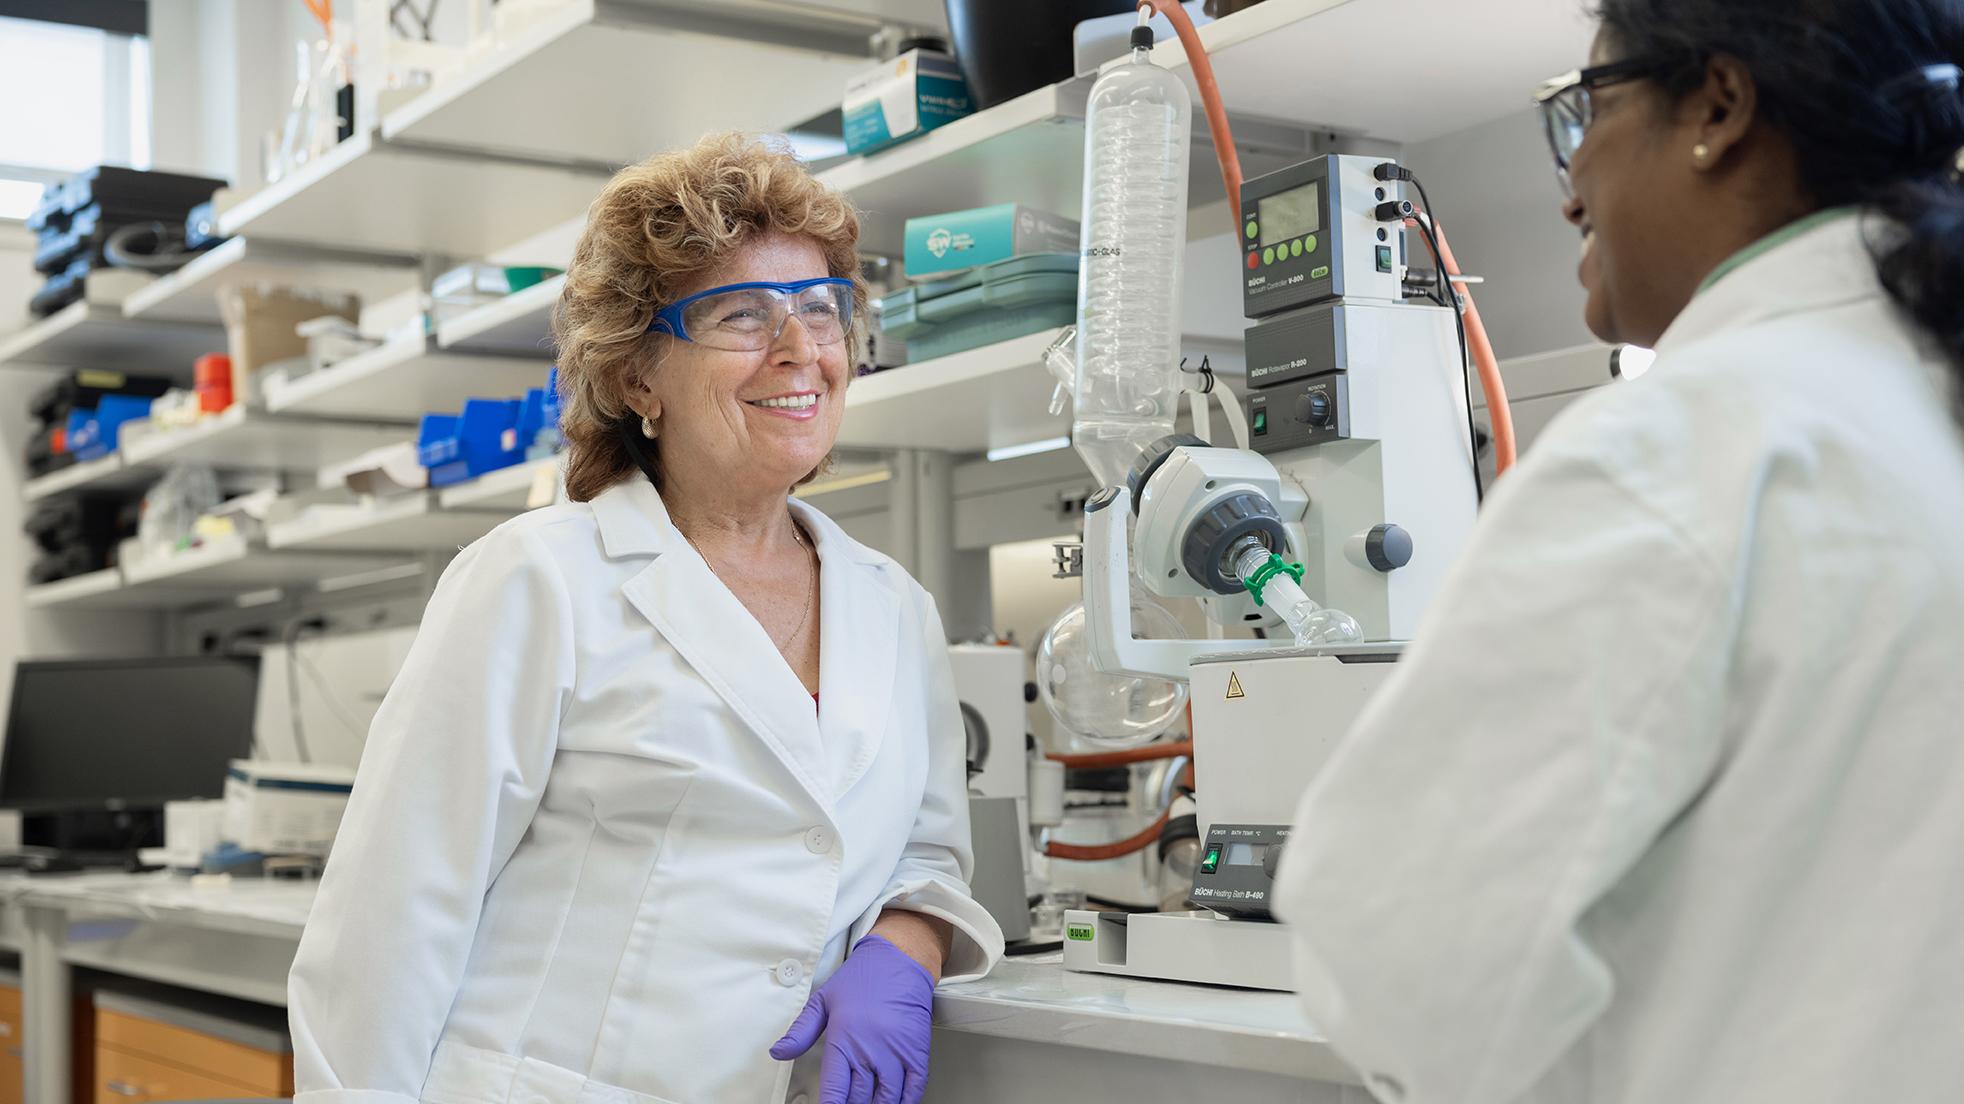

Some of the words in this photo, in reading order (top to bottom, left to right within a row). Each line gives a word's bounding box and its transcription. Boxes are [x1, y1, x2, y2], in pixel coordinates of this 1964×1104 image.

[1251, 368, 1268, 377] BÜCHI
[1194, 887, 1214, 897] BÜCHI
[1213, 889, 1232, 900] Heating
[1232, 889, 1245, 898] Bath
